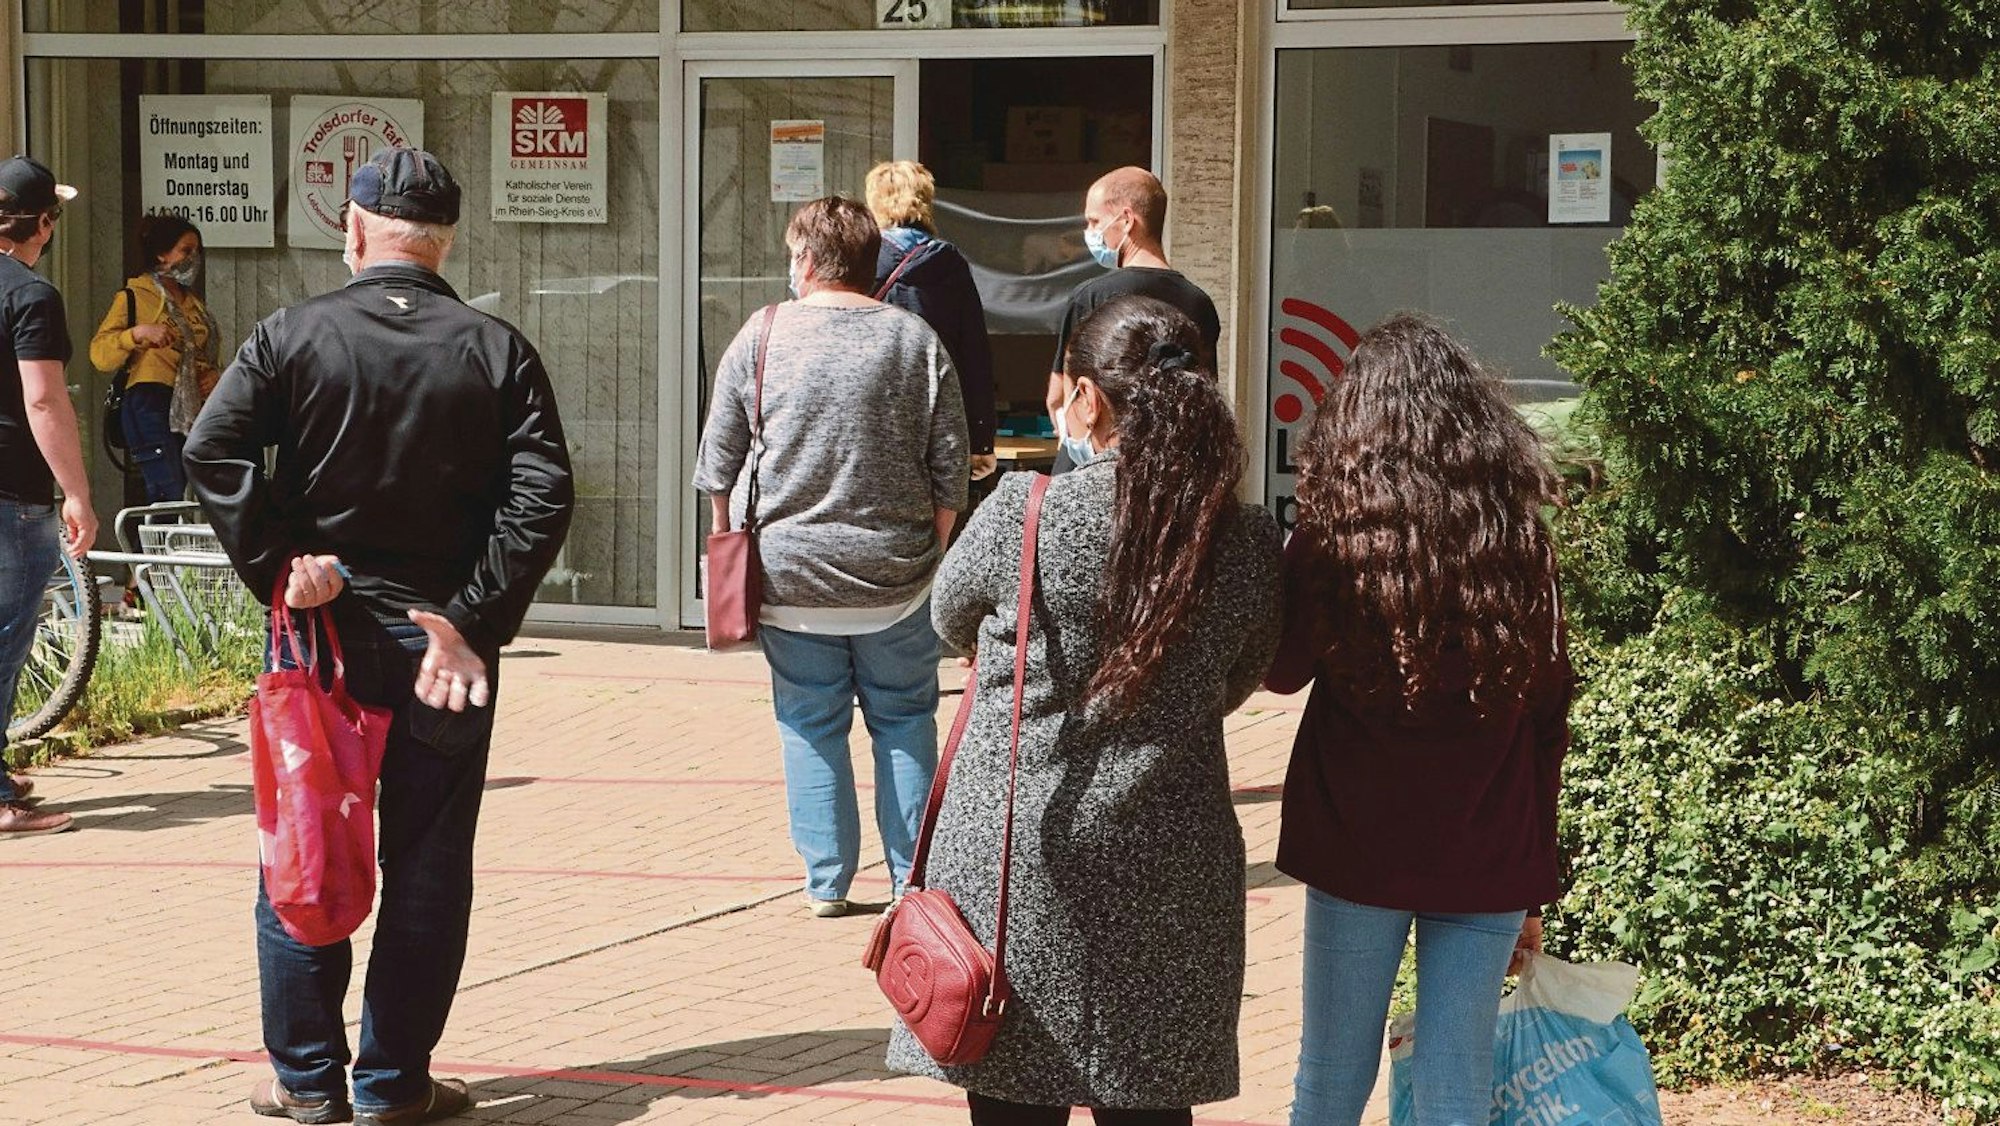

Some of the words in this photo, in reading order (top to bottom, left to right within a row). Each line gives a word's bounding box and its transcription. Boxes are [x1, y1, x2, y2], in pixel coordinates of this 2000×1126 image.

[883, 0, 927, 22] 25
[150, 114, 262, 138] Öffnungszeiten:
[304, 109, 378, 154] Troisdorfer
[514, 130, 585, 154] SKM
[165, 153, 218, 172] Montag
[223, 153, 249, 169] und
[510, 159, 588, 170] GEMEINSAM
[307, 172, 333, 183] SKM
[505, 180, 561, 190] Katholischer
[563, 180, 592, 190] Verein
[166, 179, 249, 199] Donnerstag
[507, 193, 519, 203] für
[522, 193, 553, 203] soziale
[555, 193, 591, 203] Dienste
[242, 205, 268, 222] Uhr
[495, 206, 507, 216] im
[508, 206, 585, 218] Rhein-Sieg-Kreis
